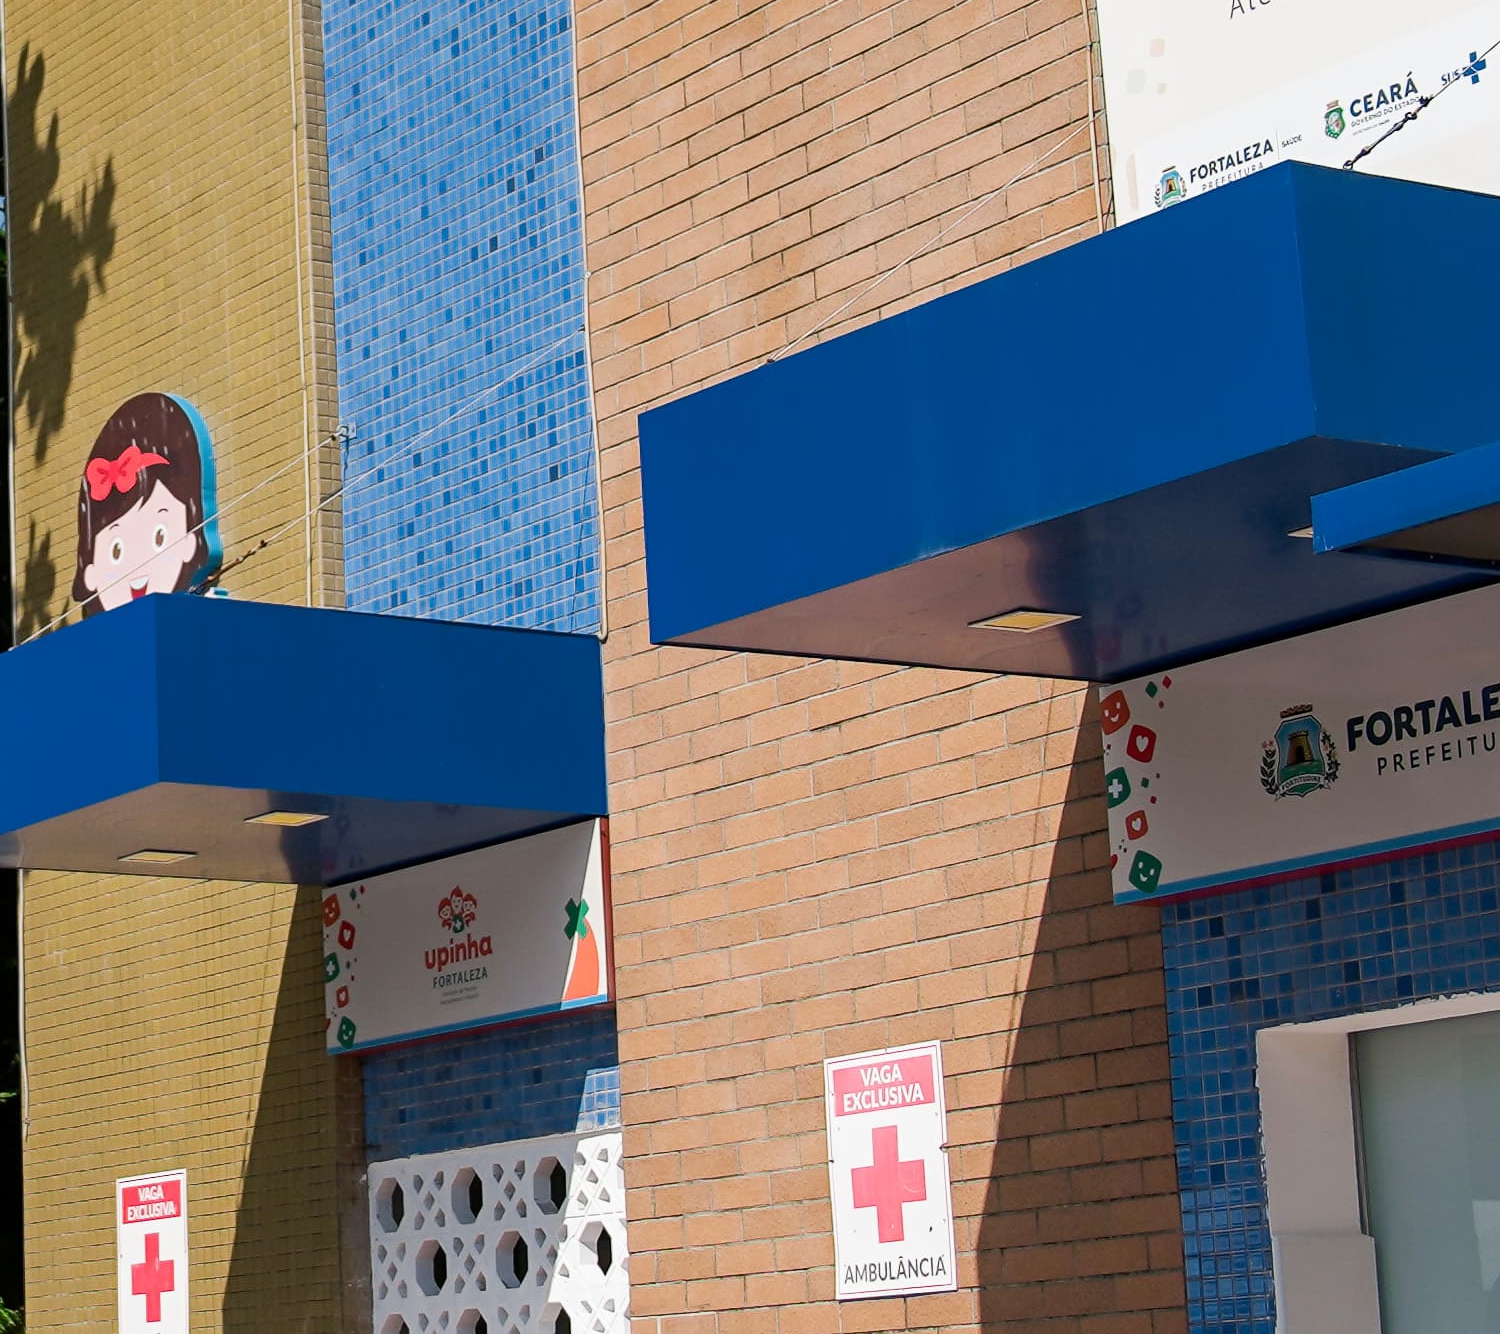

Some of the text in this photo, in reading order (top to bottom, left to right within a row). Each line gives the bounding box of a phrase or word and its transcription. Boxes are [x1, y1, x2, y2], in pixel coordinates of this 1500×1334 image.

[1350, 71, 1418, 117] CEARÁ
[1190, 139, 1274, 183] FORTALEZA
[424, 933, 493, 972] upinha
[433, 967, 488, 989] FORTALEZA
[860, 1063, 903, 1087] VAGA
[843, 1082, 924, 1113] EXCLUSIVA
[138, 1185, 165, 1202] VAGA
[127, 1200, 177, 1221] EXCLUSIVA
[844, 1255, 946, 1285] AMBULÂNCIA
